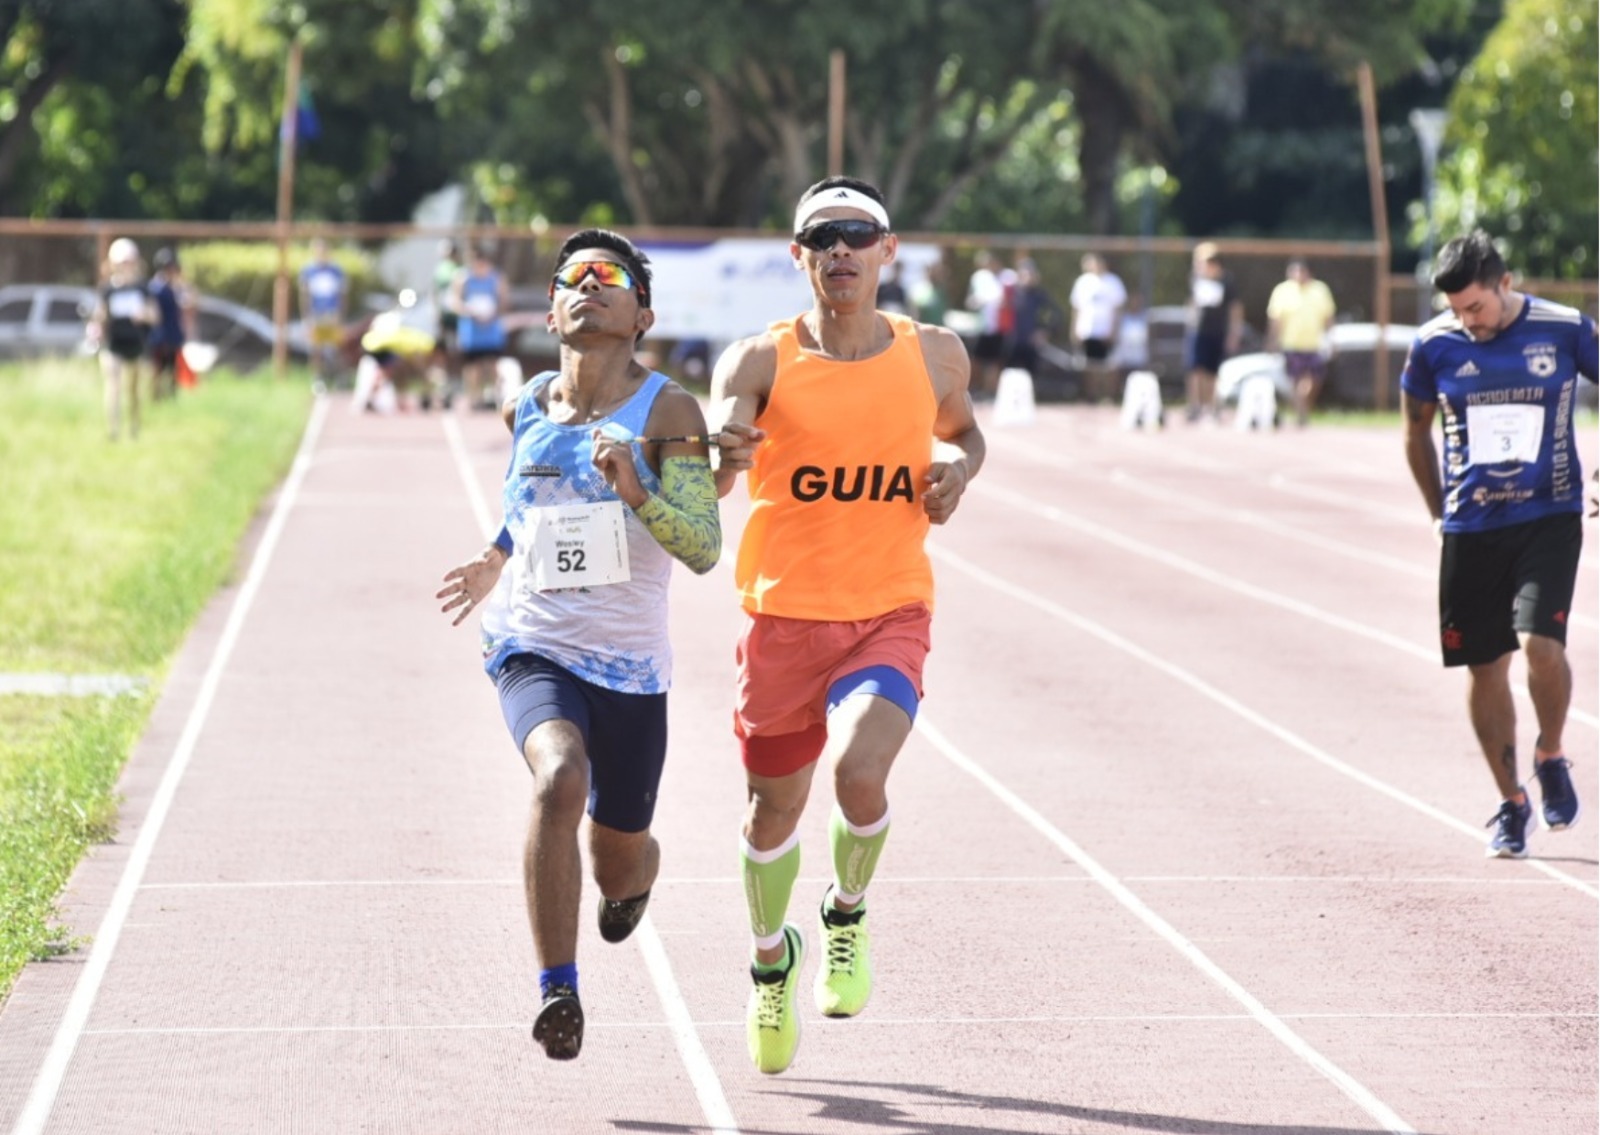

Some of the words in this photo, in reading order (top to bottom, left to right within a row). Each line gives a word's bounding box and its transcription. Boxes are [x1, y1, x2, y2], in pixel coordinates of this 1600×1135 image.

[1466, 386, 1544, 405] ACADEMIA
[1501, 436, 1512, 452] 3
[790, 465, 914, 503] GUIA
[555, 539, 585, 548] Wesley
[557, 549, 587, 572] 52
